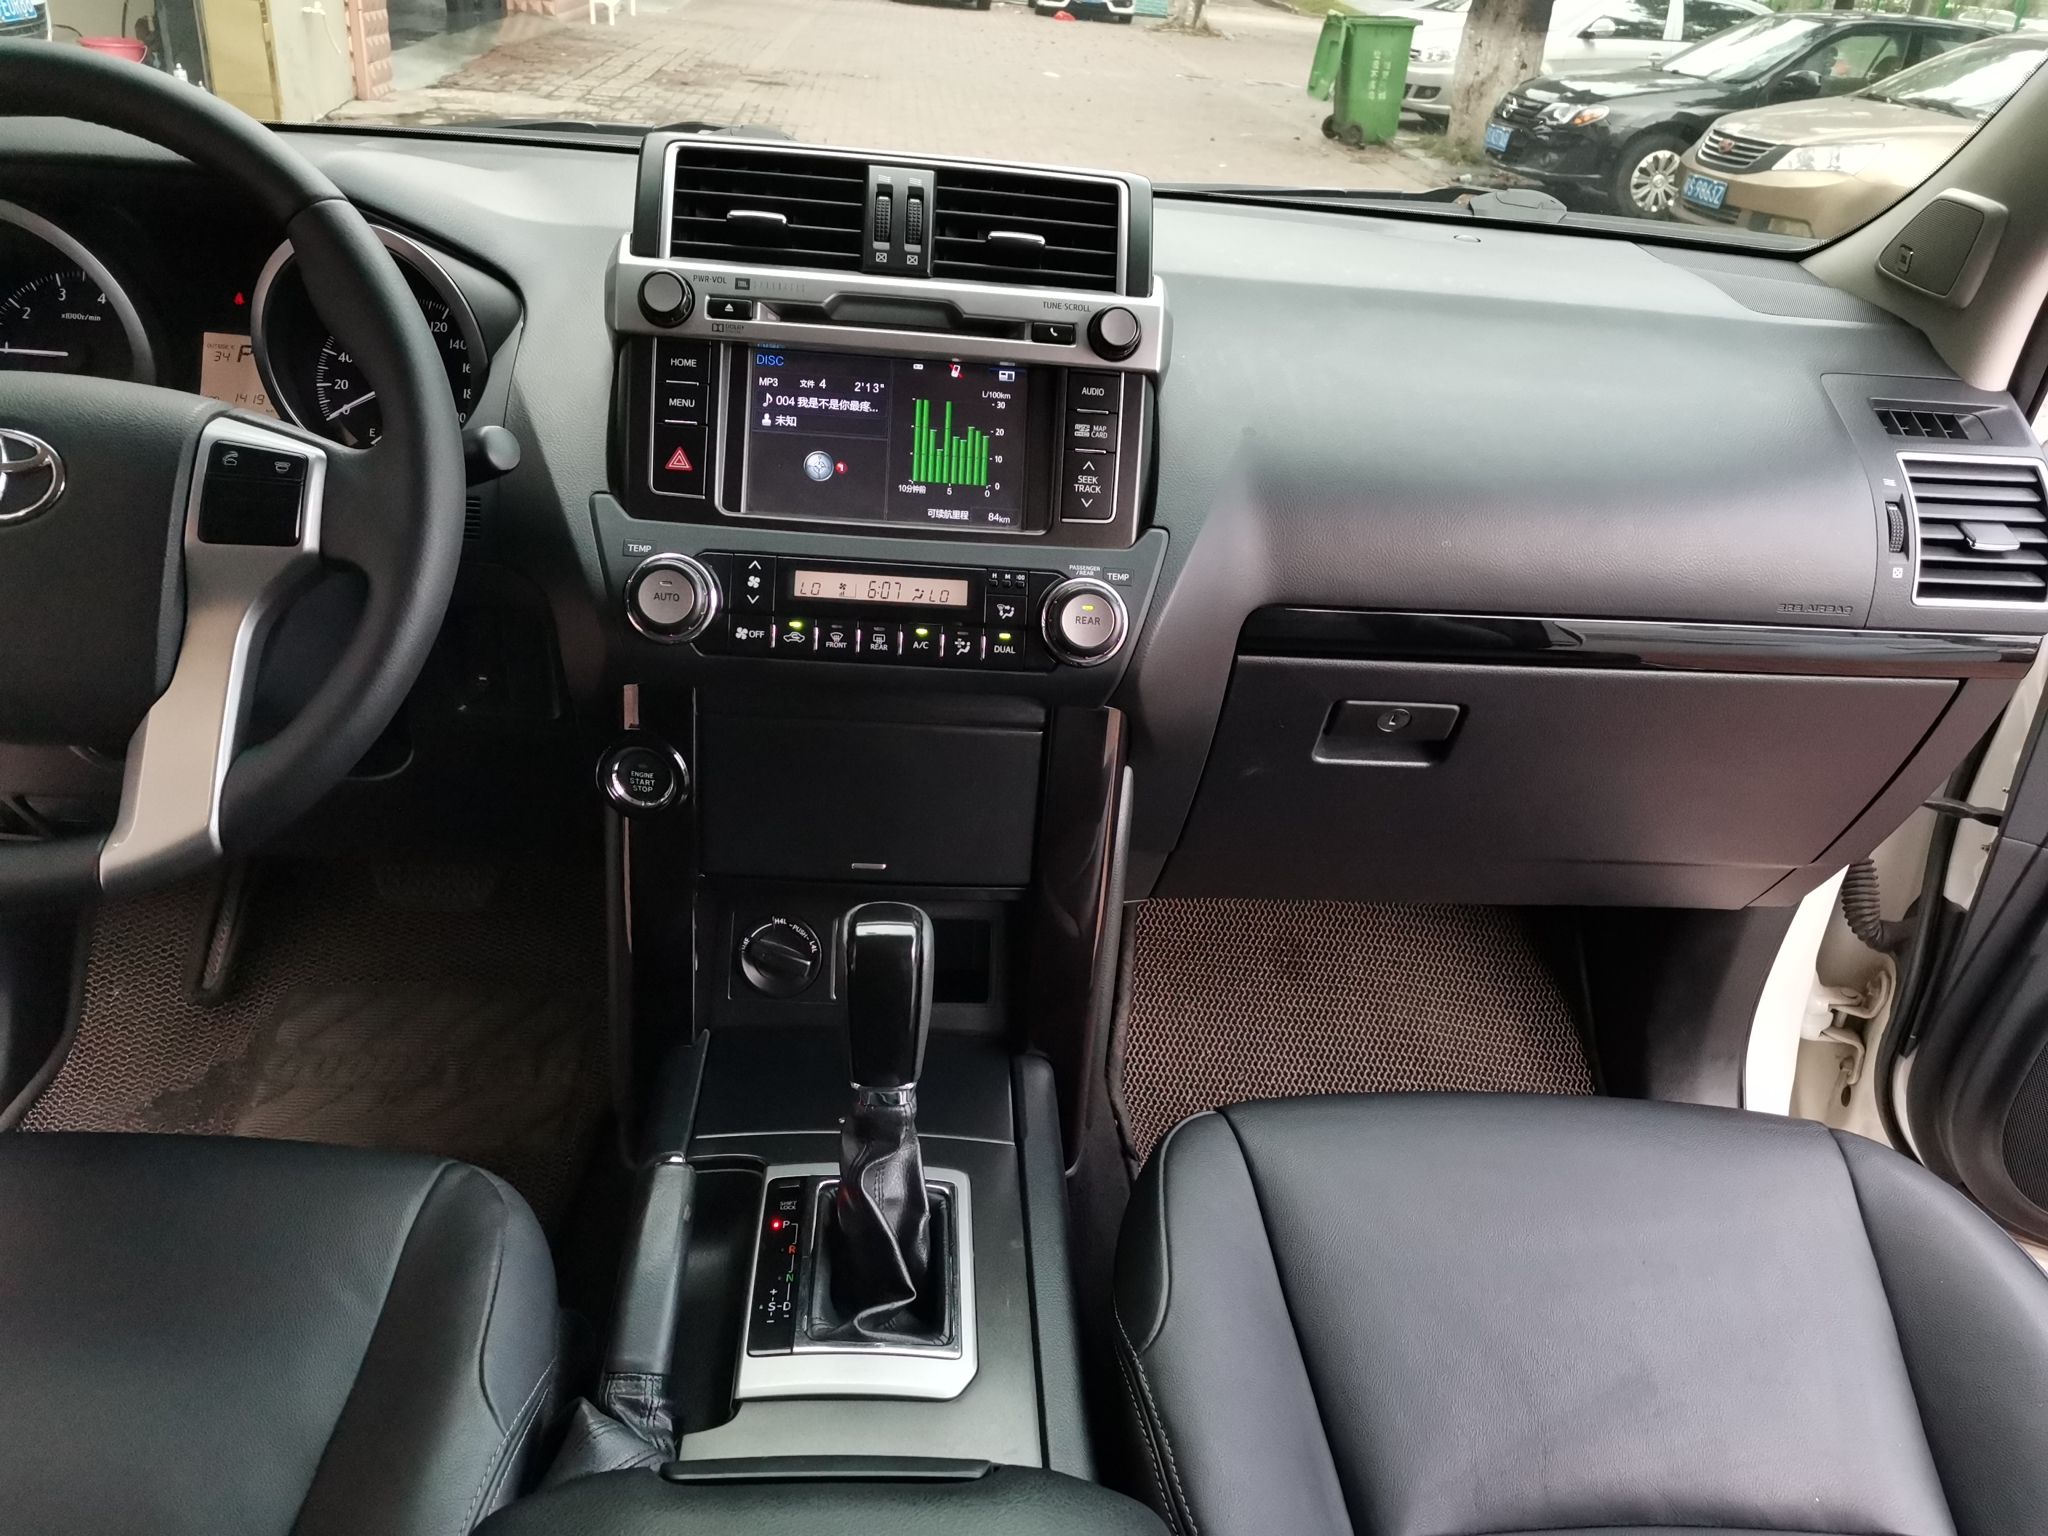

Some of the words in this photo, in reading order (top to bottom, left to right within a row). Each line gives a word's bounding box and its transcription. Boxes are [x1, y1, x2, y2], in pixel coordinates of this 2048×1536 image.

[58, 288, 66, 301] 3
[97, 292, 106, 304] 4
[22, 306, 31, 319] 2
[430, 321, 448, 333] 120
[670, 357, 697, 368] HOME
[756, 354, 784, 366] DISC
[334, 379, 349, 390] 20
[758, 377, 779, 387] MP3
[818, 378, 827, 389] 4
[1081, 387, 1105, 396] AUDIO
[668, 397, 696, 408] MENU
[775, 395, 796, 406] 004
[996, 401, 1006, 409] 30
[774, 414, 797, 427] 未知
[369, 428, 376, 437] E
[995, 428, 1005, 436] 20
[1092, 424, 1107, 432] MAP
[1091, 431, 1108, 439] CARD
[994, 455, 1003, 463] 10
[1077, 475, 1099, 484] SEEK
[994, 482, 1000, 490] 0
[1074, 484, 1102, 494] TRACK
[946, 487, 953, 496] 5
[984, 490, 991, 498] 0
[627, 543, 652, 553] TEMP
[1069, 564, 1101, 572] PASSENGER
[1107, 573, 1130, 581] TEMP
[867, 579, 902, 600] 6:07
[653, 592, 680, 602] AUTO
[1075, 615, 1101, 625] REAR
[749, 630, 765, 639] OFF
[825, 641, 848, 649] FRONT
[870, 643, 888, 651] REAR
[913, 640, 930, 650] A/C
[993, 645, 1016, 654] DUAL
[630, 770, 654, 779] ENGINE
[630, 778, 655, 786] START
[782, 1220, 790, 1229] P
[788, 1245, 796, 1254] R
[786, 1273, 794, 1282] N
